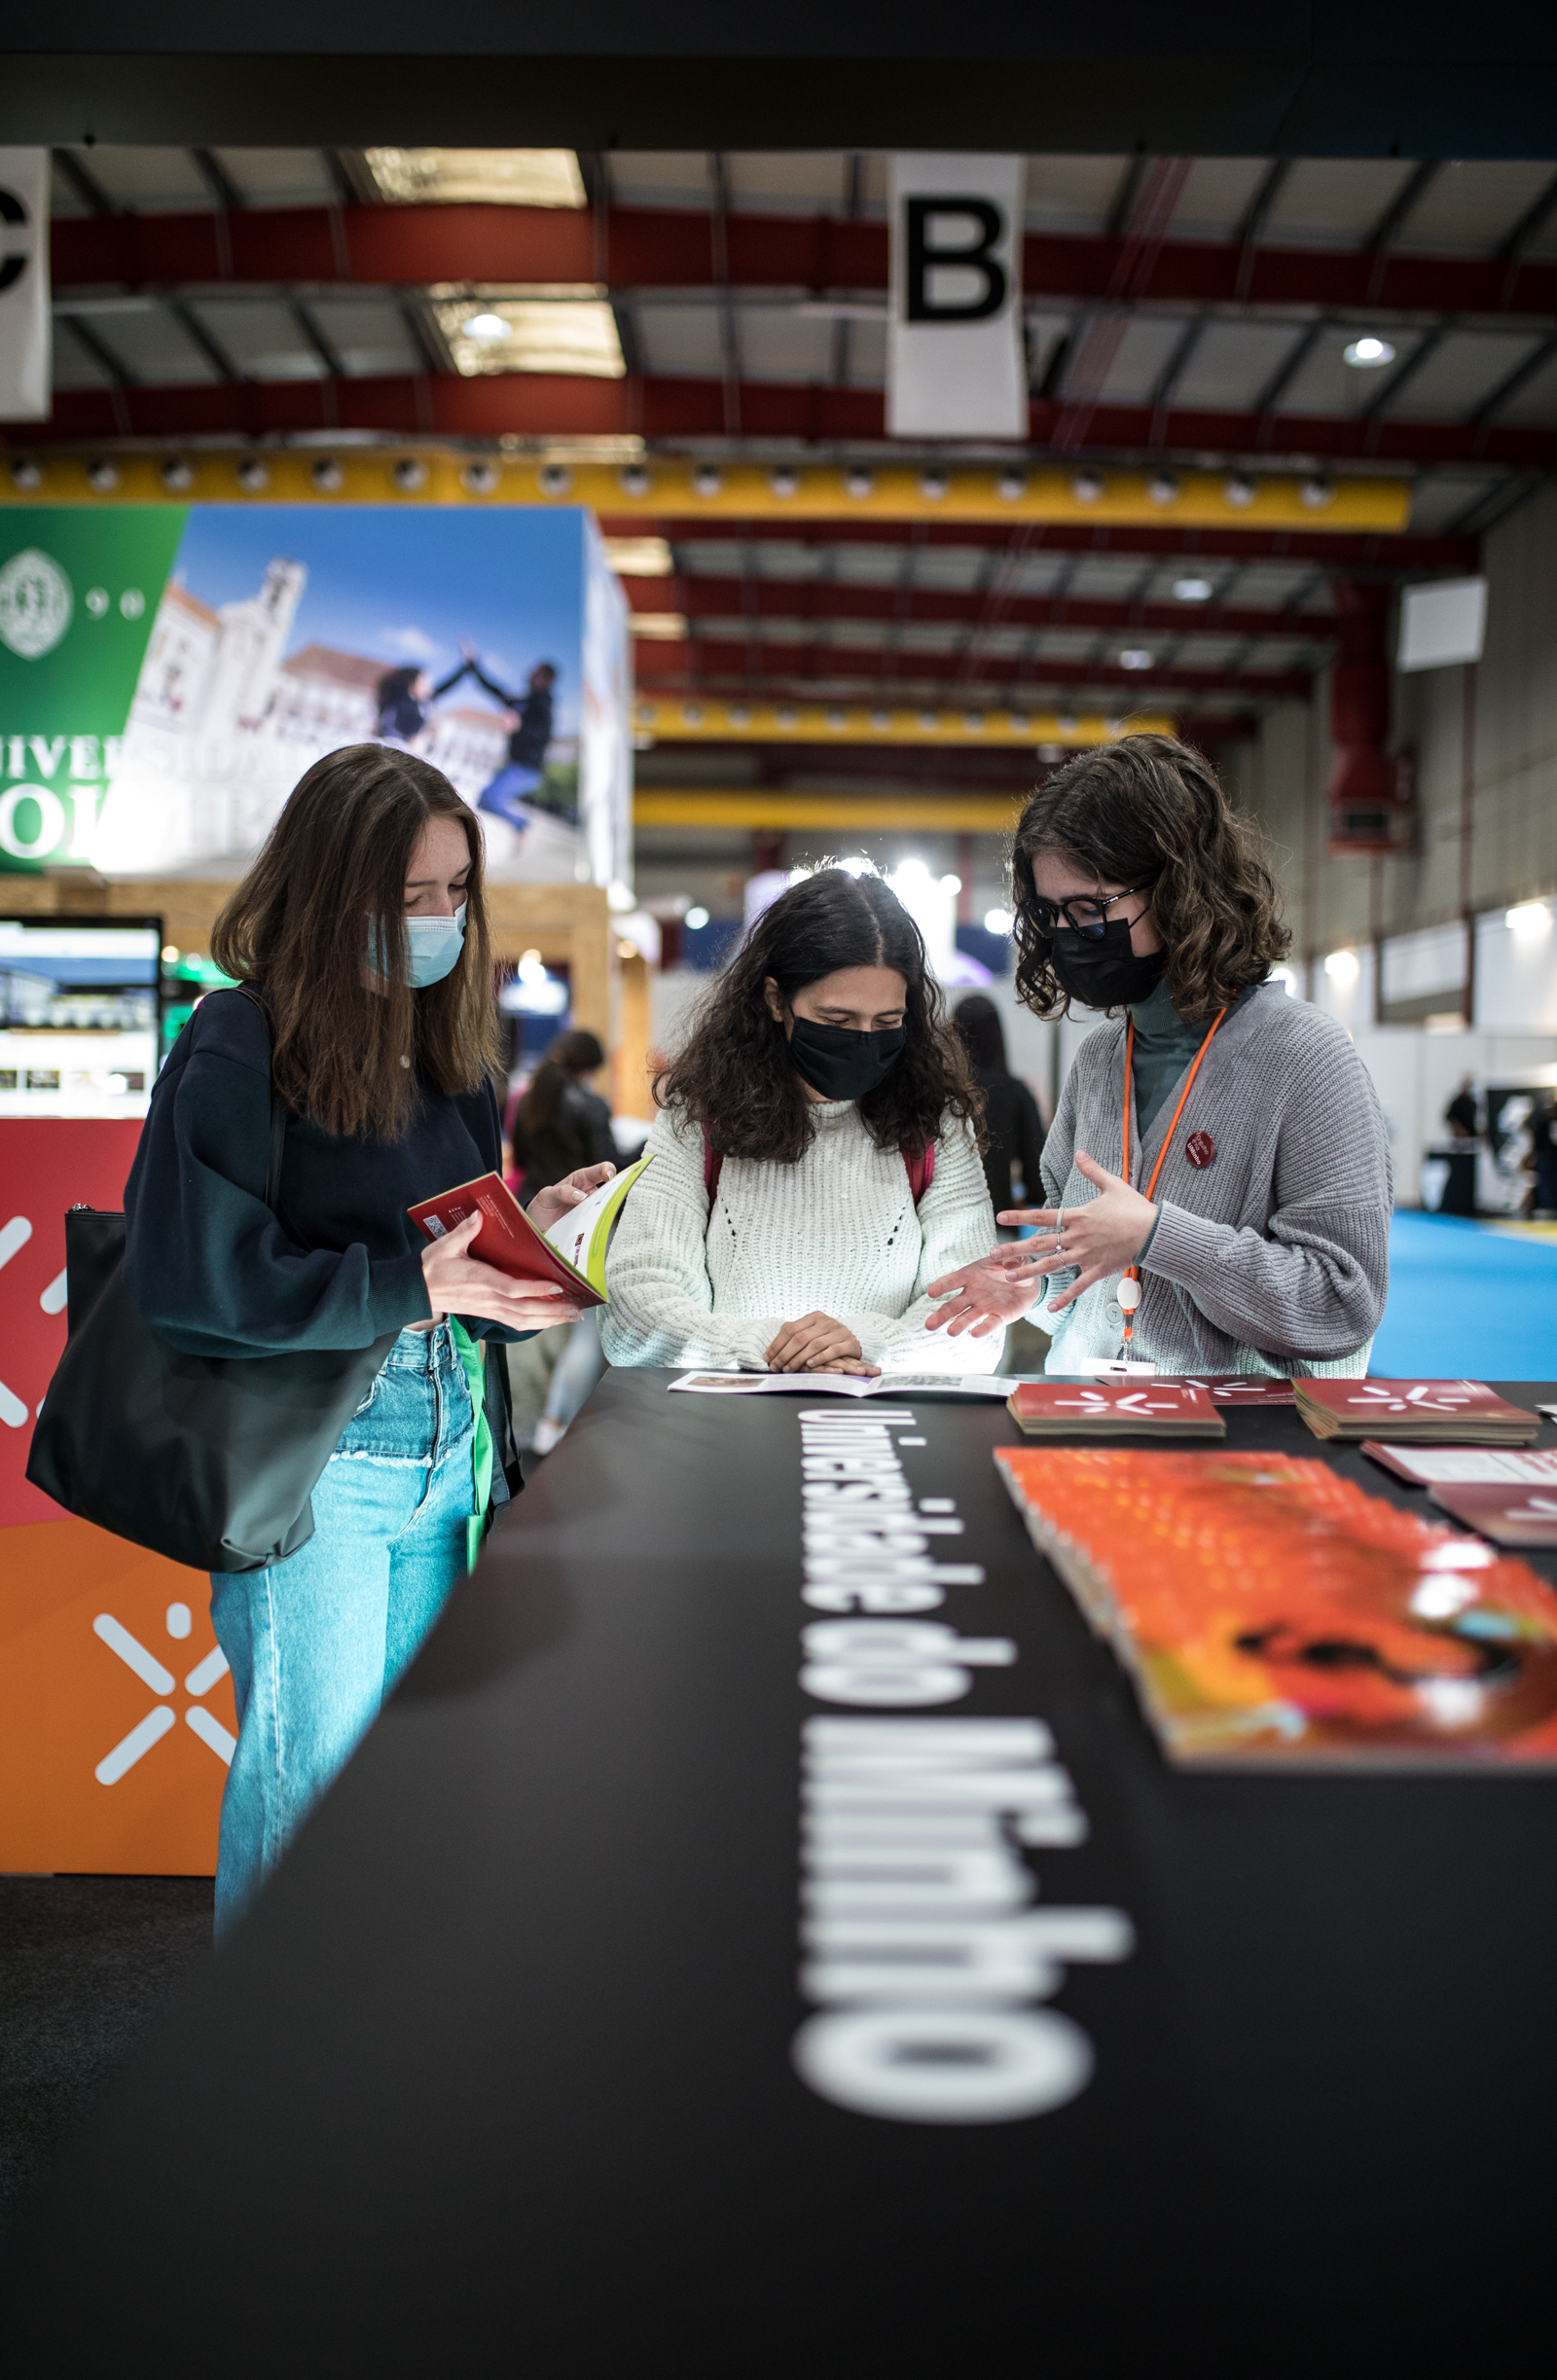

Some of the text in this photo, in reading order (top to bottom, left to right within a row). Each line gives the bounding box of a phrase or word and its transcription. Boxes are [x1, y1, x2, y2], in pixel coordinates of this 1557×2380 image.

[906, 197, 1007, 322] B
[1187, 1142, 1201, 1165] UMinho
[791, 1409, 1136, 2124] Universidade do Minho
